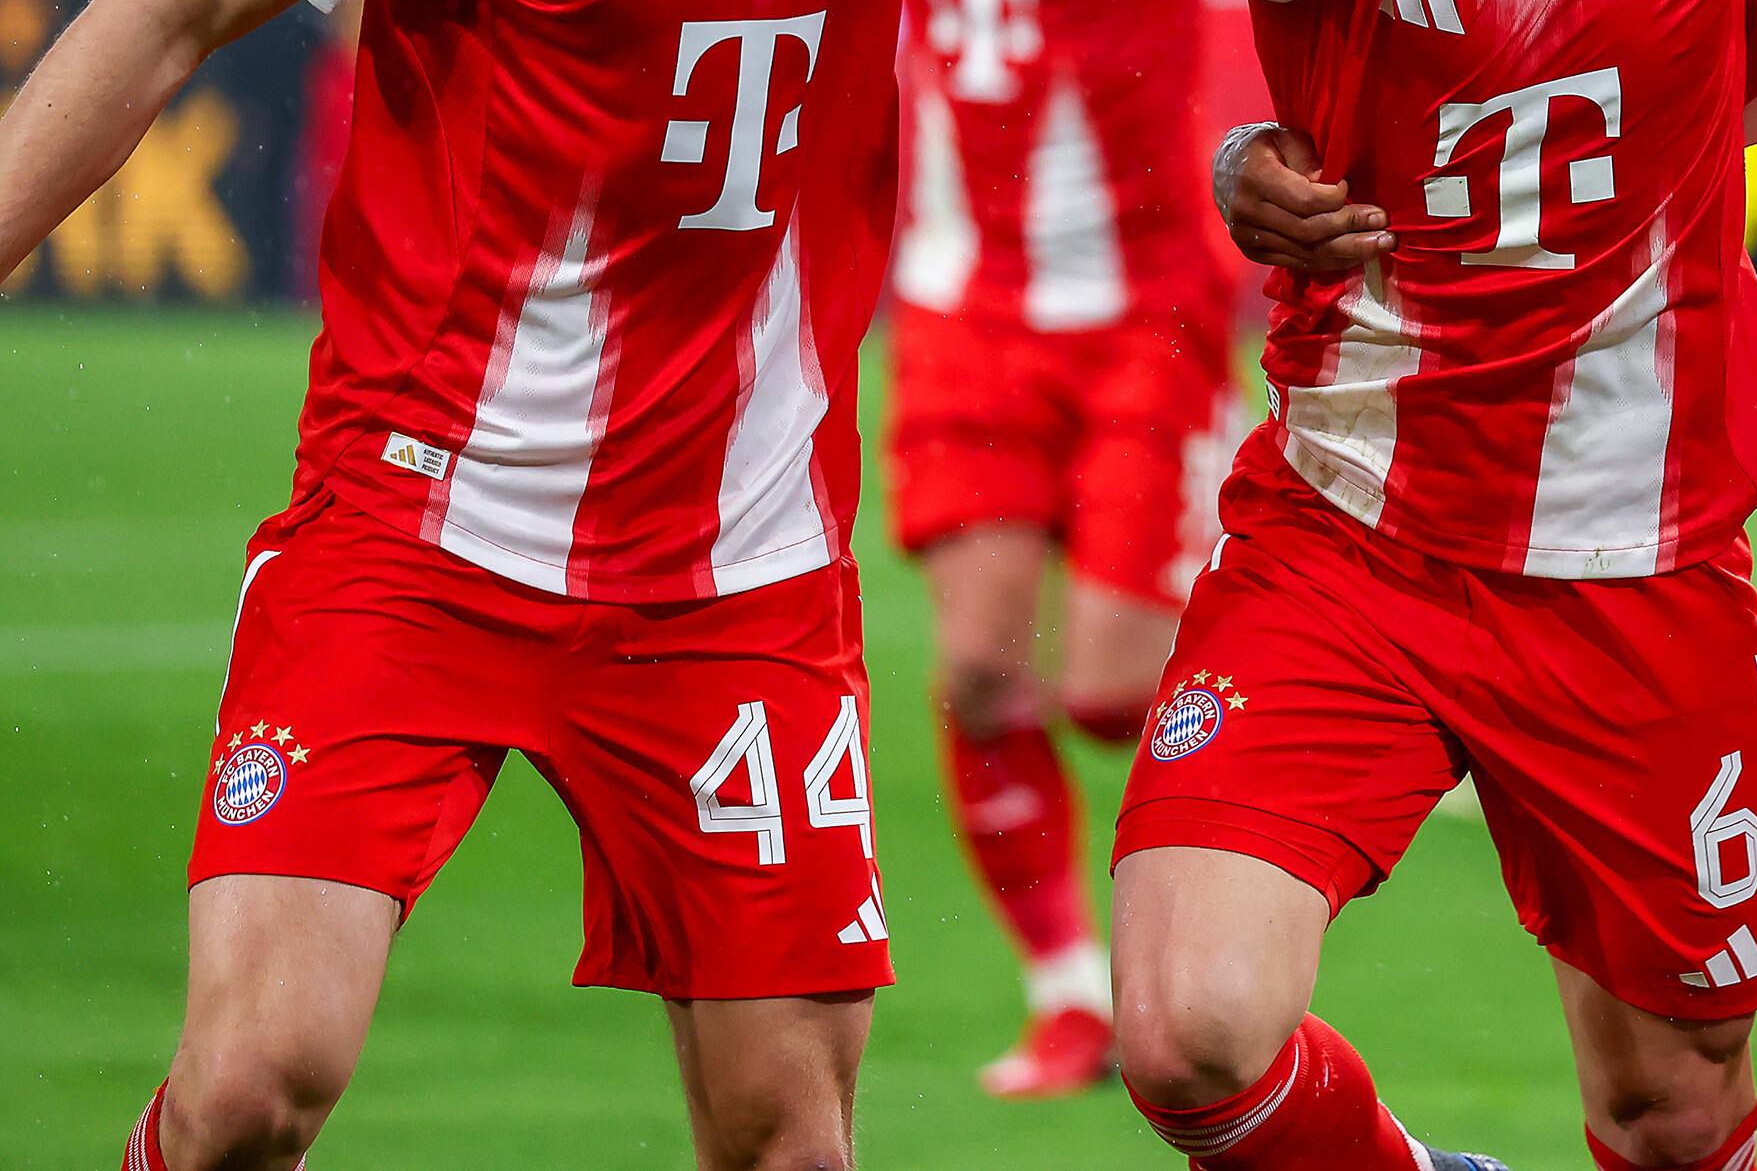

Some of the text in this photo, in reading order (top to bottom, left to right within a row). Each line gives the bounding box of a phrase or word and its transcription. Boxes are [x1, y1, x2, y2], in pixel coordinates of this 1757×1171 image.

[661, 10, 827, 231] T
[1424, 66, 1621, 270] T
[221, 749, 279, 784] FC BAYERN
[689, 695, 873, 865] 44
[1176, 694, 1215, 720] BAYERN
